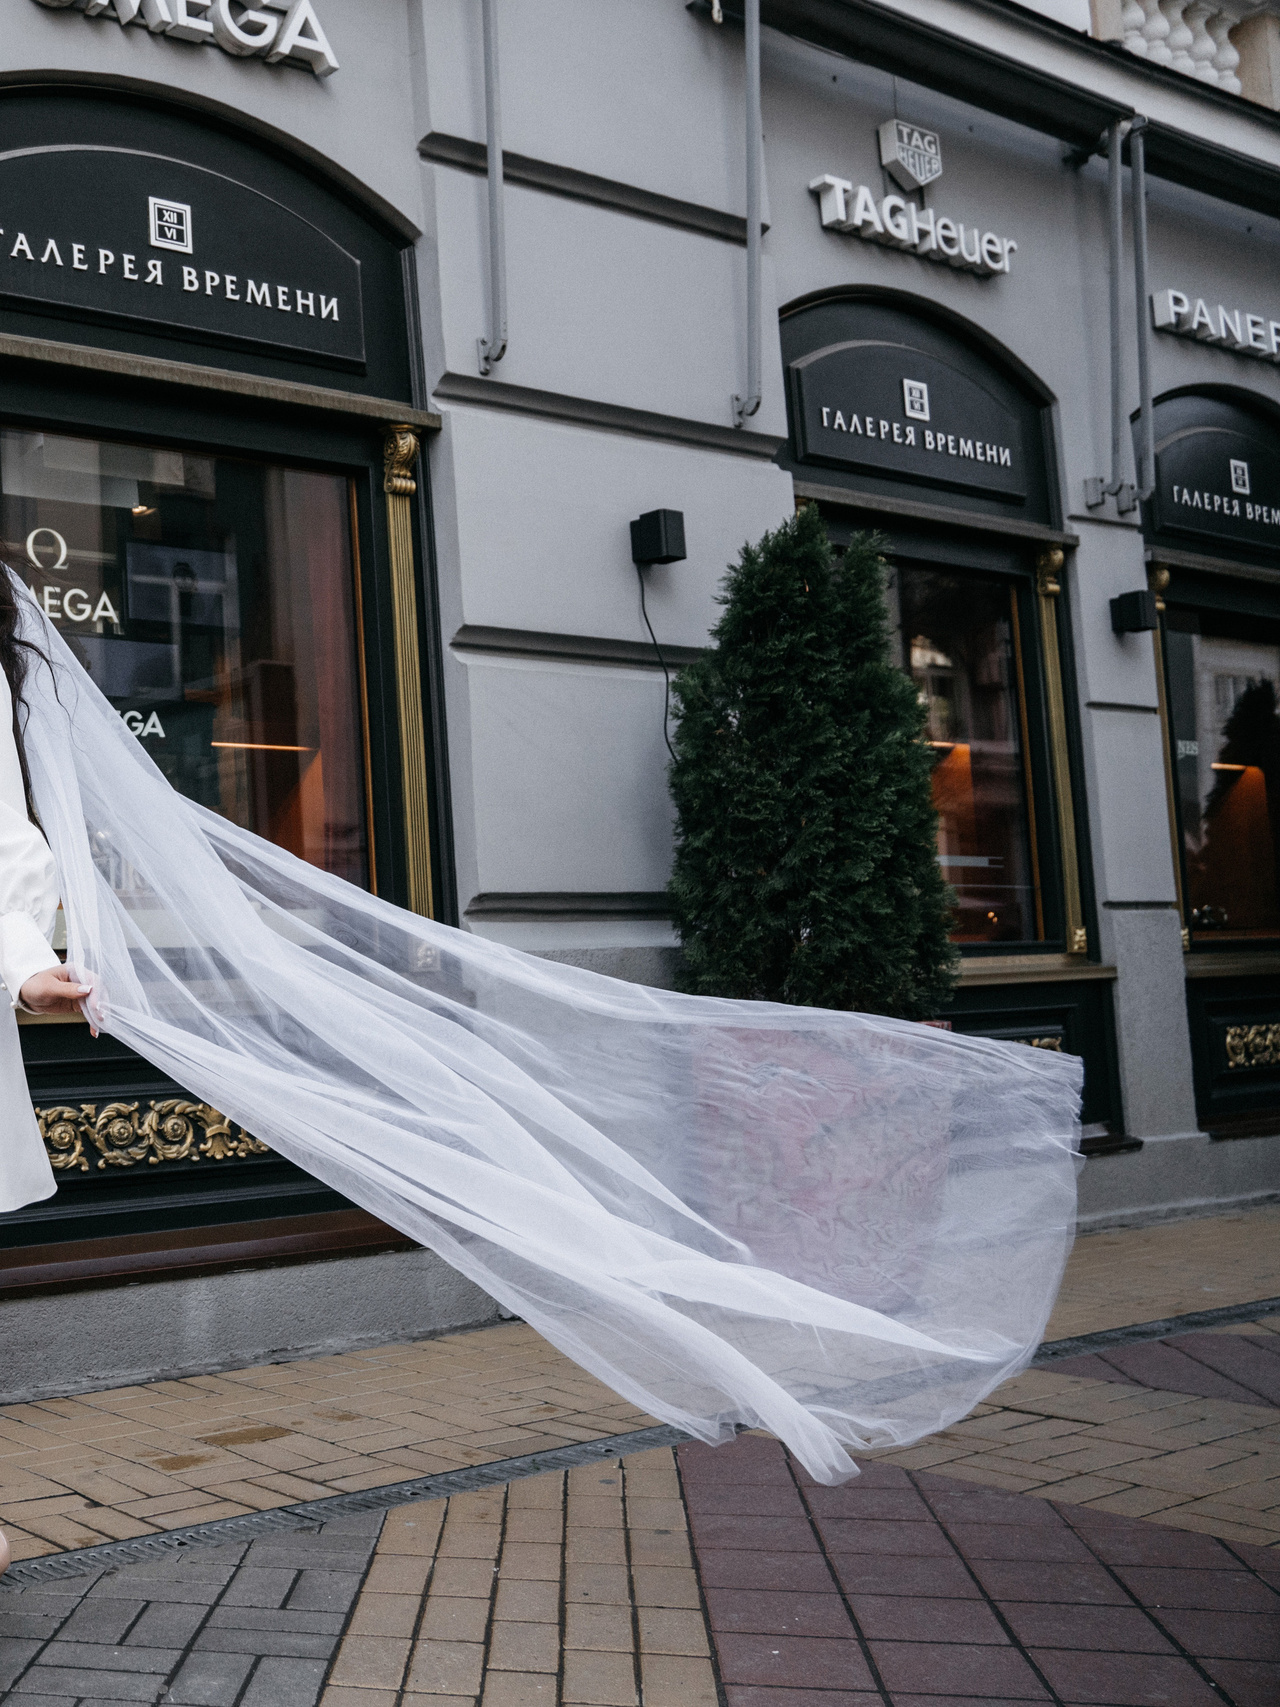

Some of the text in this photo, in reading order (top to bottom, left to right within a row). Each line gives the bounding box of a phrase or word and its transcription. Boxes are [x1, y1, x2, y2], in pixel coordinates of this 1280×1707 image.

[36, 0, 340, 77] EGA
[898, 124, 937, 155] TAG
[162, 210, 178, 224] XII
[164, 226, 177, 240] VI
[182, 265, 339, 321] ВРЕМЕНИ
[822, 406, 1011, 467] ГАЛЕРЕЯ ВРЕМЕНИ
[1173, 485, 1240, 517] ГАЛЕРЕЯ
[29, 584, 120, 624] EGA
